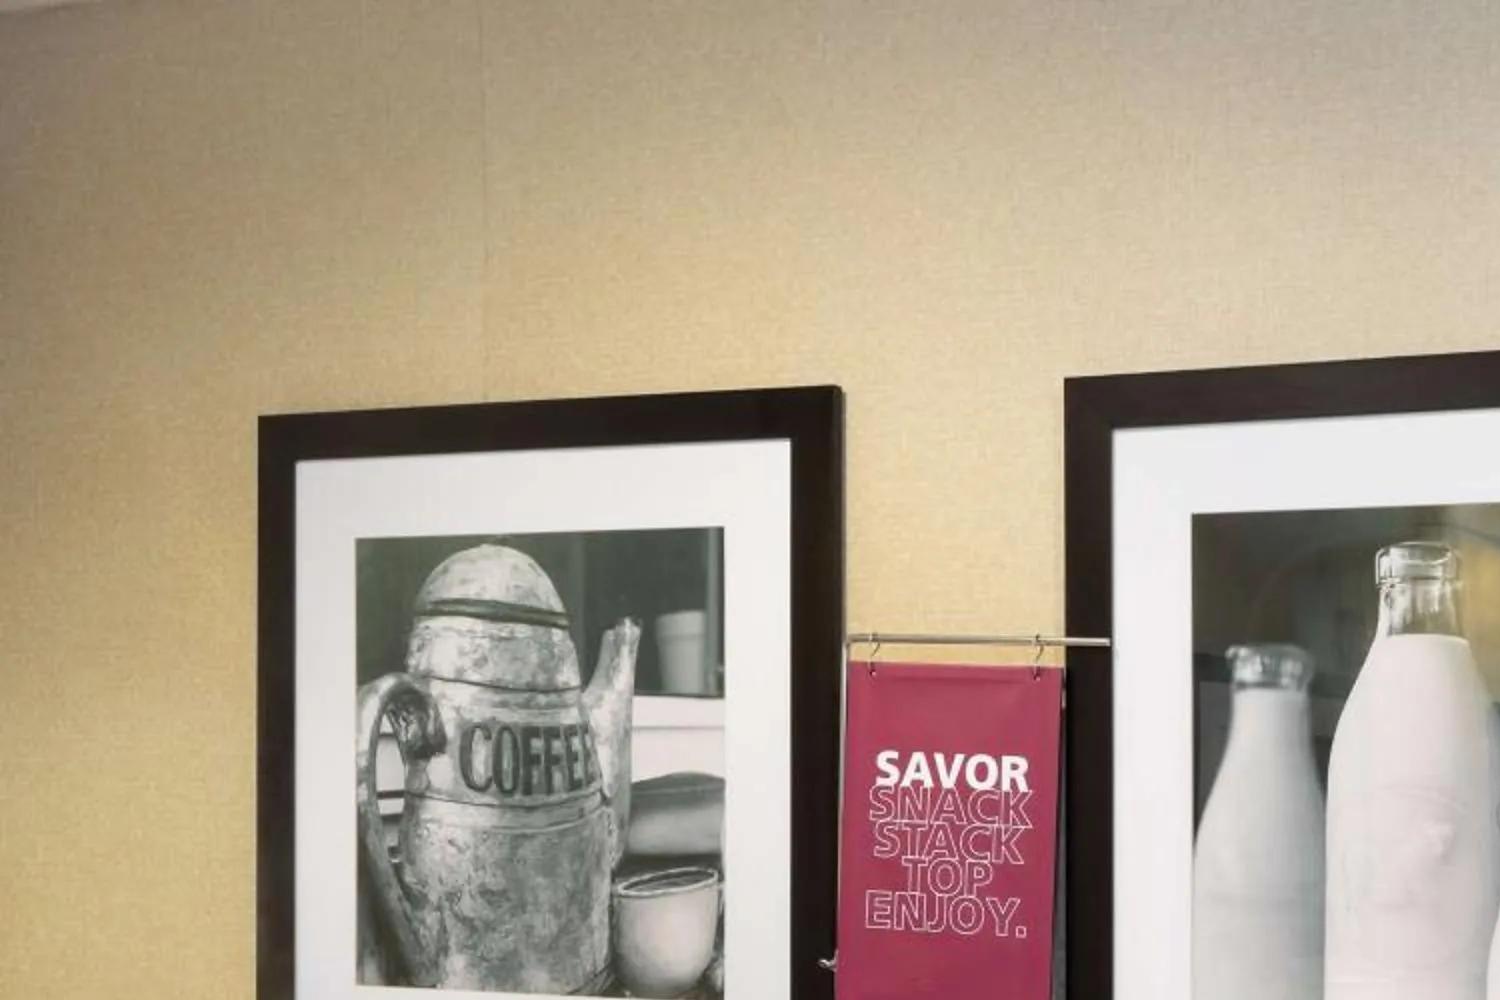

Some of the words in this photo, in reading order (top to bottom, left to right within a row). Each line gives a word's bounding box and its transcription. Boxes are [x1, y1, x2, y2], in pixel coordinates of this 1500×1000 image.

[876, 751, 1029, 792] SAVOR
[869, 784, 1033, 828] SNACK
[873, 820, 1024, 864] STACK
[902, 855, 993, 898] TOP
[865, 890, 1027, 938] ENJOY.
